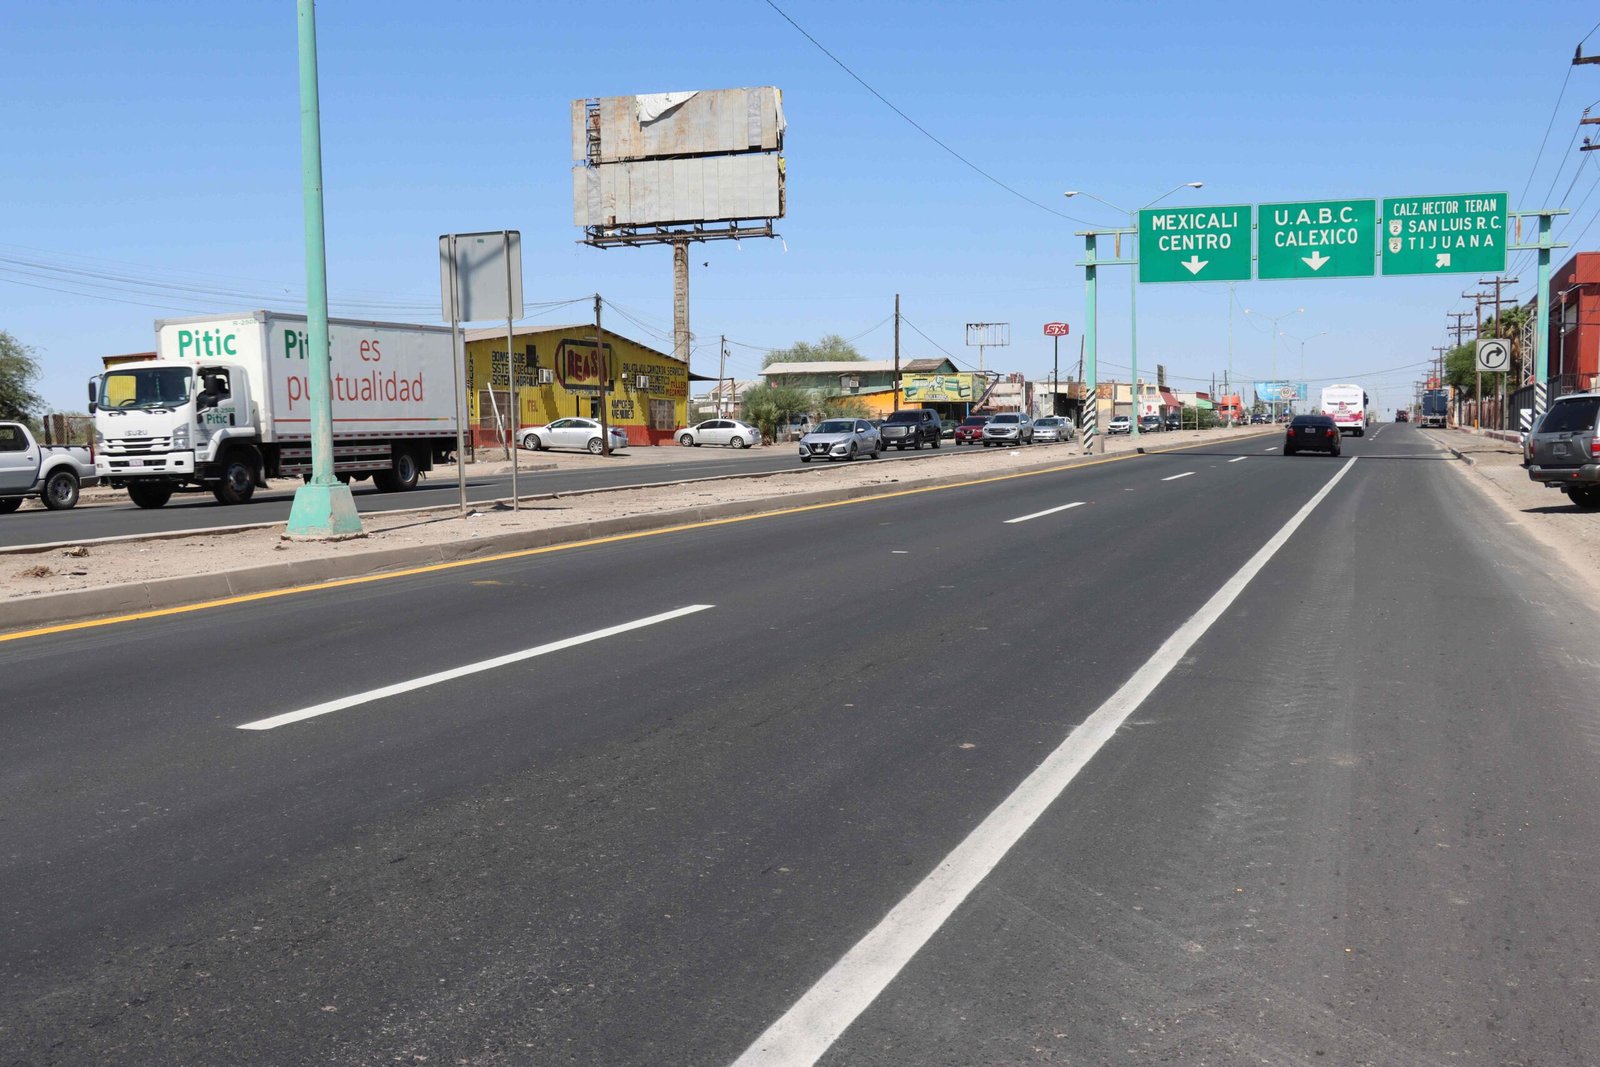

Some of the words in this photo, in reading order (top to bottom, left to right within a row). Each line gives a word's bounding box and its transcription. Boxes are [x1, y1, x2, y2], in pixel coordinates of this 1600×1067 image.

[1422, 201, 1459, 215] HECTOR
[1464, 199, 1497, 213] TERAN
[1152, 212, 1238, 231] MEXICALI
[1408, 219, 1437, 233] SAN
[1441, 217, 1472, 231] LUIS
[1158, 233, 1232, 251] CENTRO
[1274, 228, 1358, 247] CALEXICO
[1408, 234, 1494, 250] TIJUANA
[178, 328, 237, 358] Pitic
[359, 339, 381, 361] es
[206, 413, 228, 425] Pitic
[124, 429, 148, 437] ISUZU
